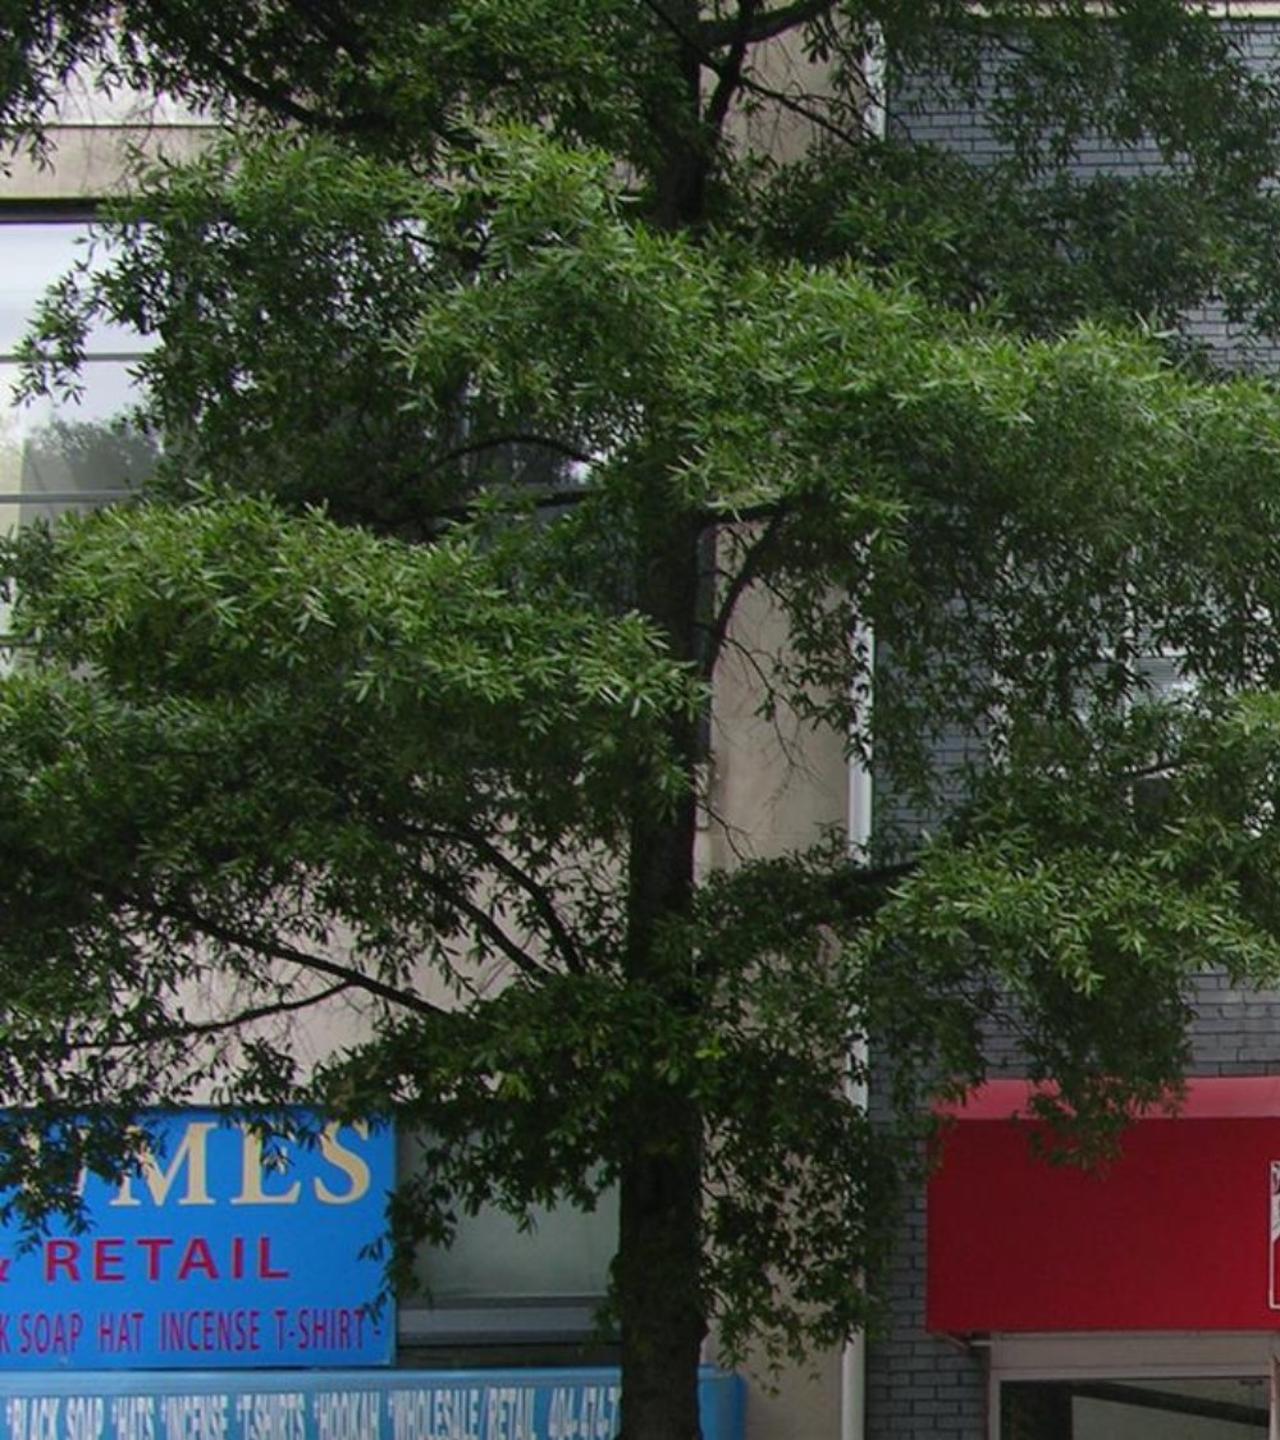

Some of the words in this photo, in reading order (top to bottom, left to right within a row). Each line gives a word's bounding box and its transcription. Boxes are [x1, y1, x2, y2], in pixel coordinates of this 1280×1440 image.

[45, 1237, 290, 1281] RETAIL
[20, 1312, 84, 1354] SOAP
[99, 1312, 144, 1352] HAT
[161, 1310, 260, 1352] INCENSE
[275, 1308, 365, 1351] T-SHIRT
